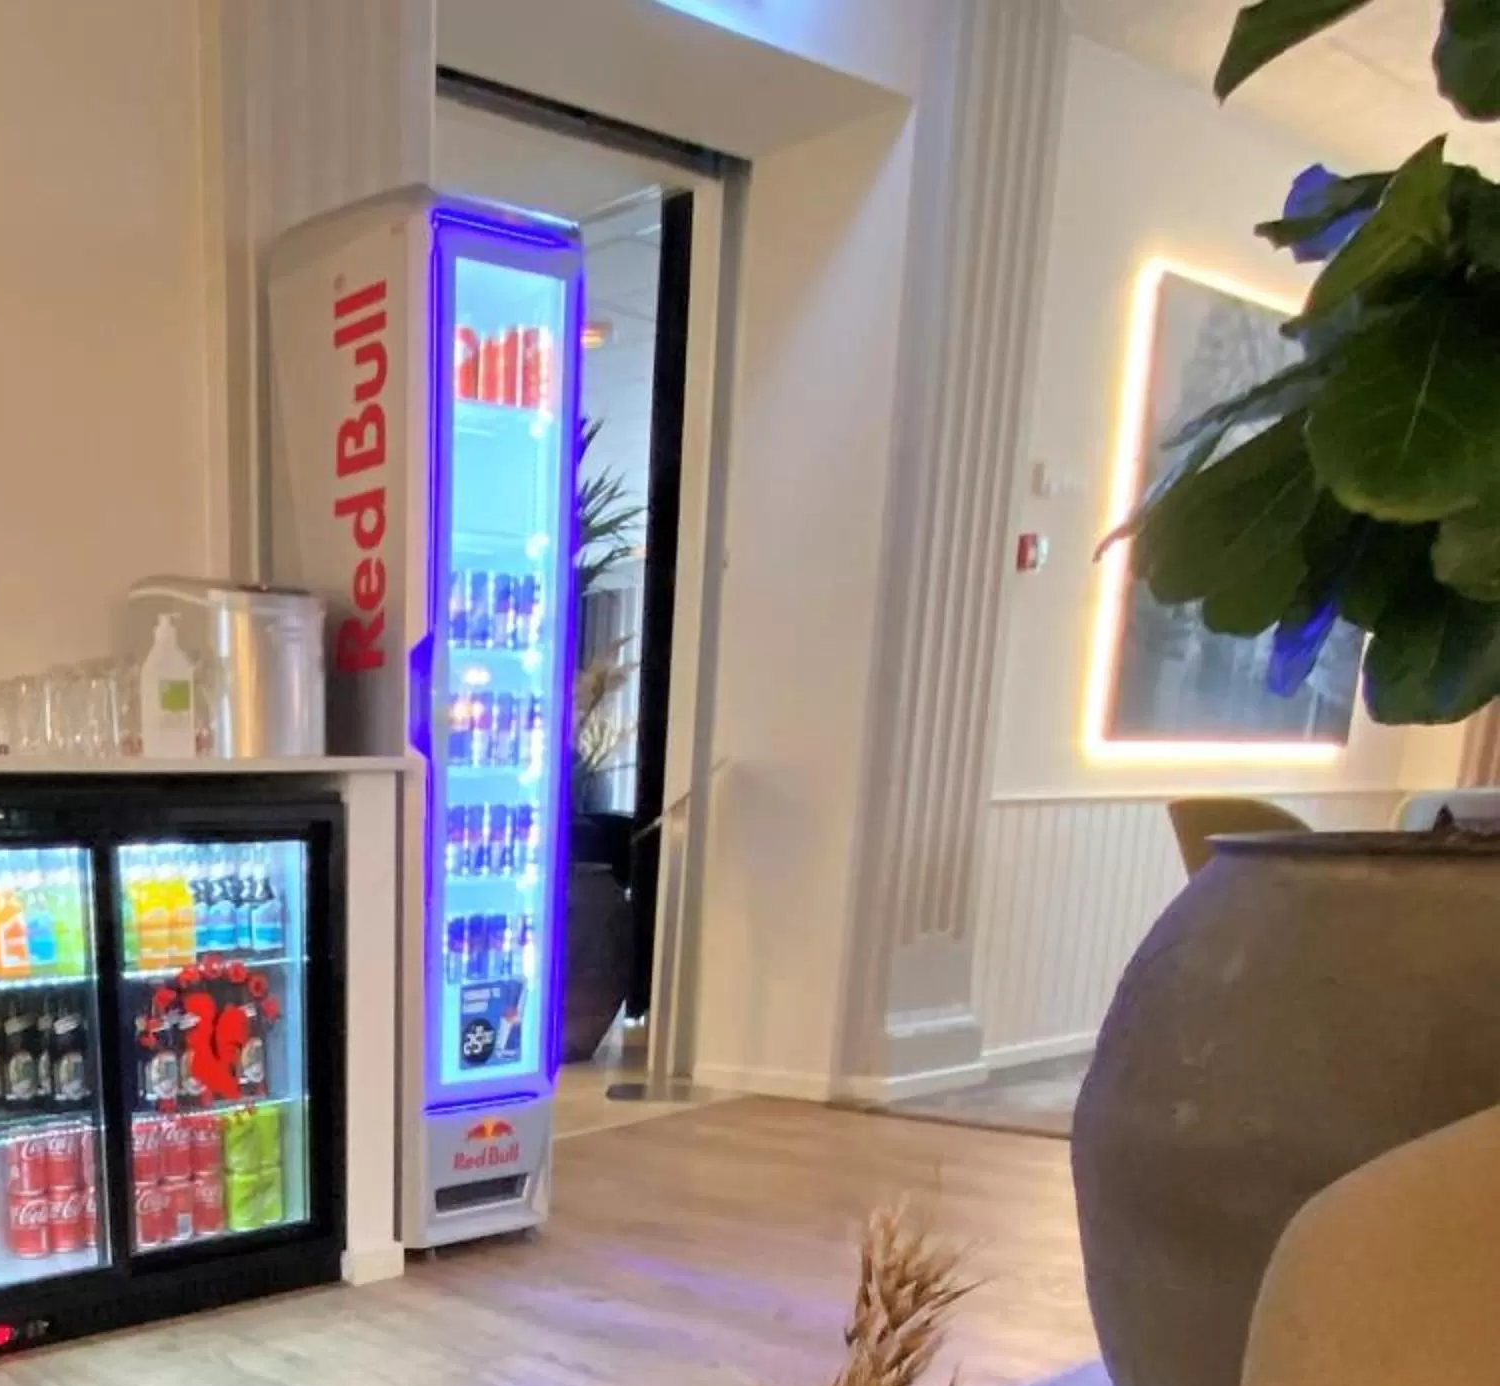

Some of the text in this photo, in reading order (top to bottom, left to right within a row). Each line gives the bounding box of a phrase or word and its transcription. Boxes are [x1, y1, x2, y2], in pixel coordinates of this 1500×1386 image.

[333, 279, 388, 673] Red Bull
[453, 1143, 520, 1170] Red Bull
